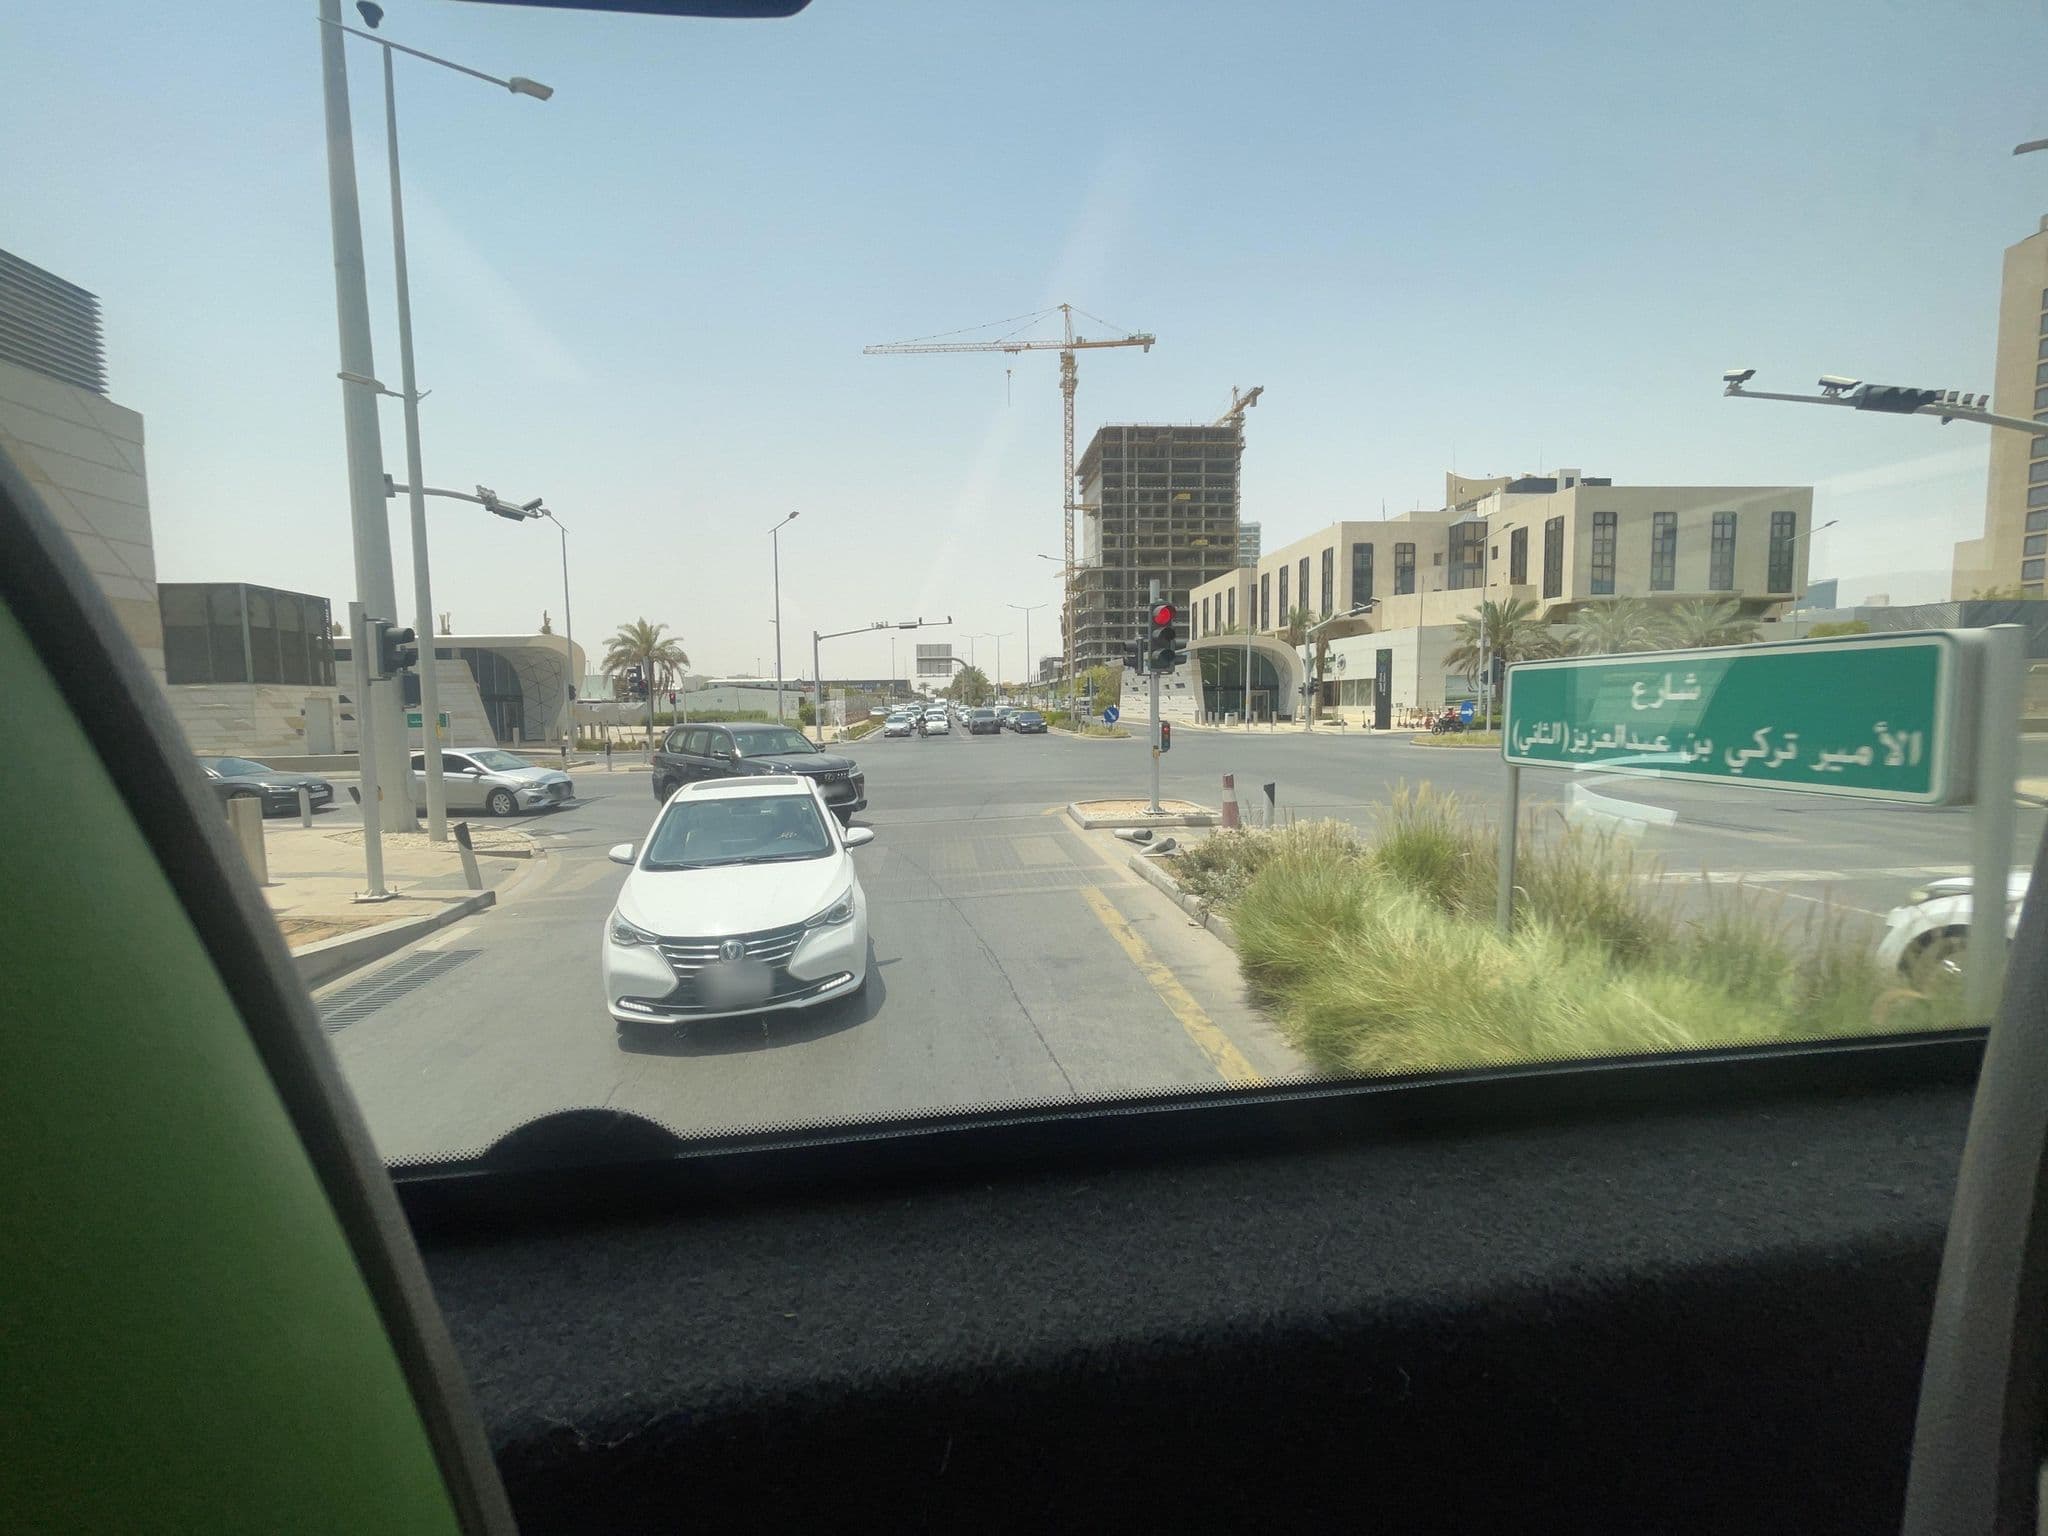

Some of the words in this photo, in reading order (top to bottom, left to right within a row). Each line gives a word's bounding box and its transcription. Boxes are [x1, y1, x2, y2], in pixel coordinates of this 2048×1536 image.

[1631, 673, 1700, 710] شارع
[1568, 723, 1671, 754] عبدالعزيز
[1680, 733, 1713, 761] بن
[1724, 726, 1800, 774] تركي
[1808, 721, 1922, 771] الأمير
